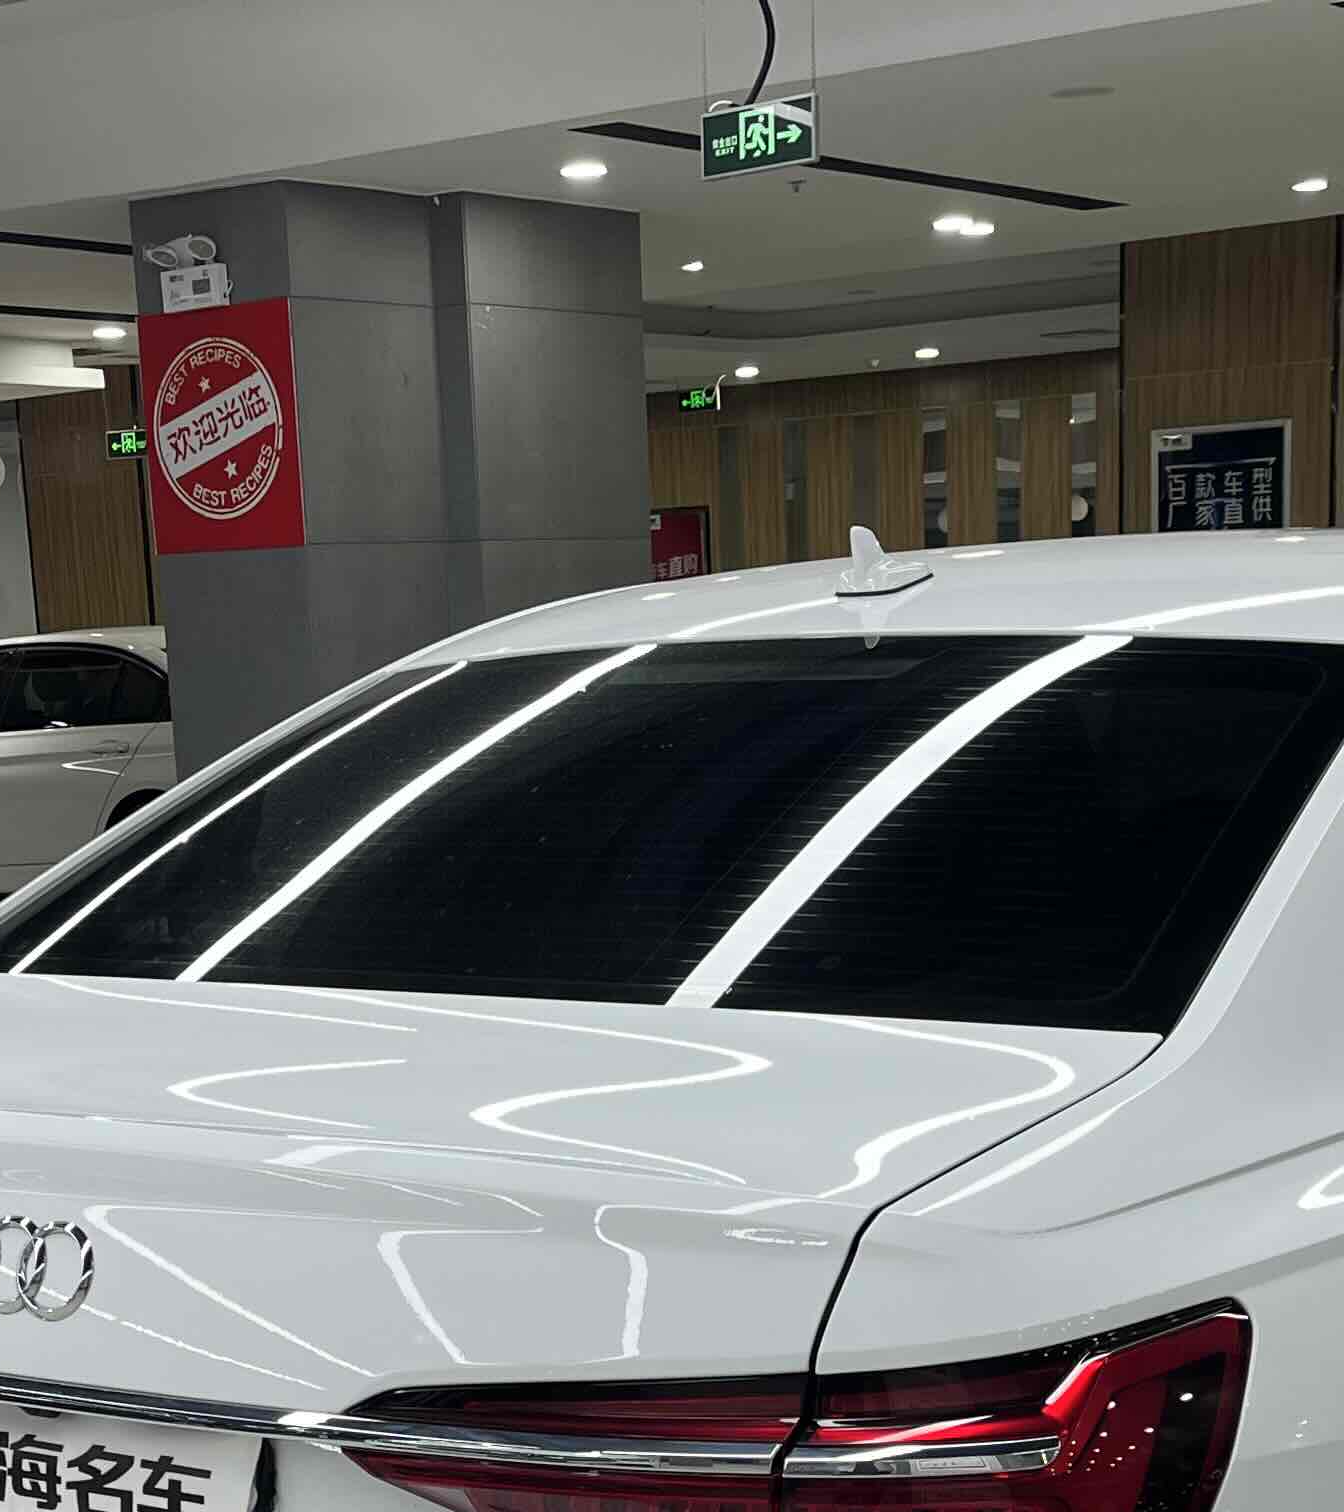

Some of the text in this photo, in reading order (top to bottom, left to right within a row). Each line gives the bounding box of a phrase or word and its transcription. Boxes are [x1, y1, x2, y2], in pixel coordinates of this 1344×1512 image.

[165, 348, 242, 406] BEST RECIPES
[193, 444, 273, 506] BEST RECIPES
[1167, 467, 1273, 500] 百款车型
[1166, 496, 1273, 528] 厂家直供
